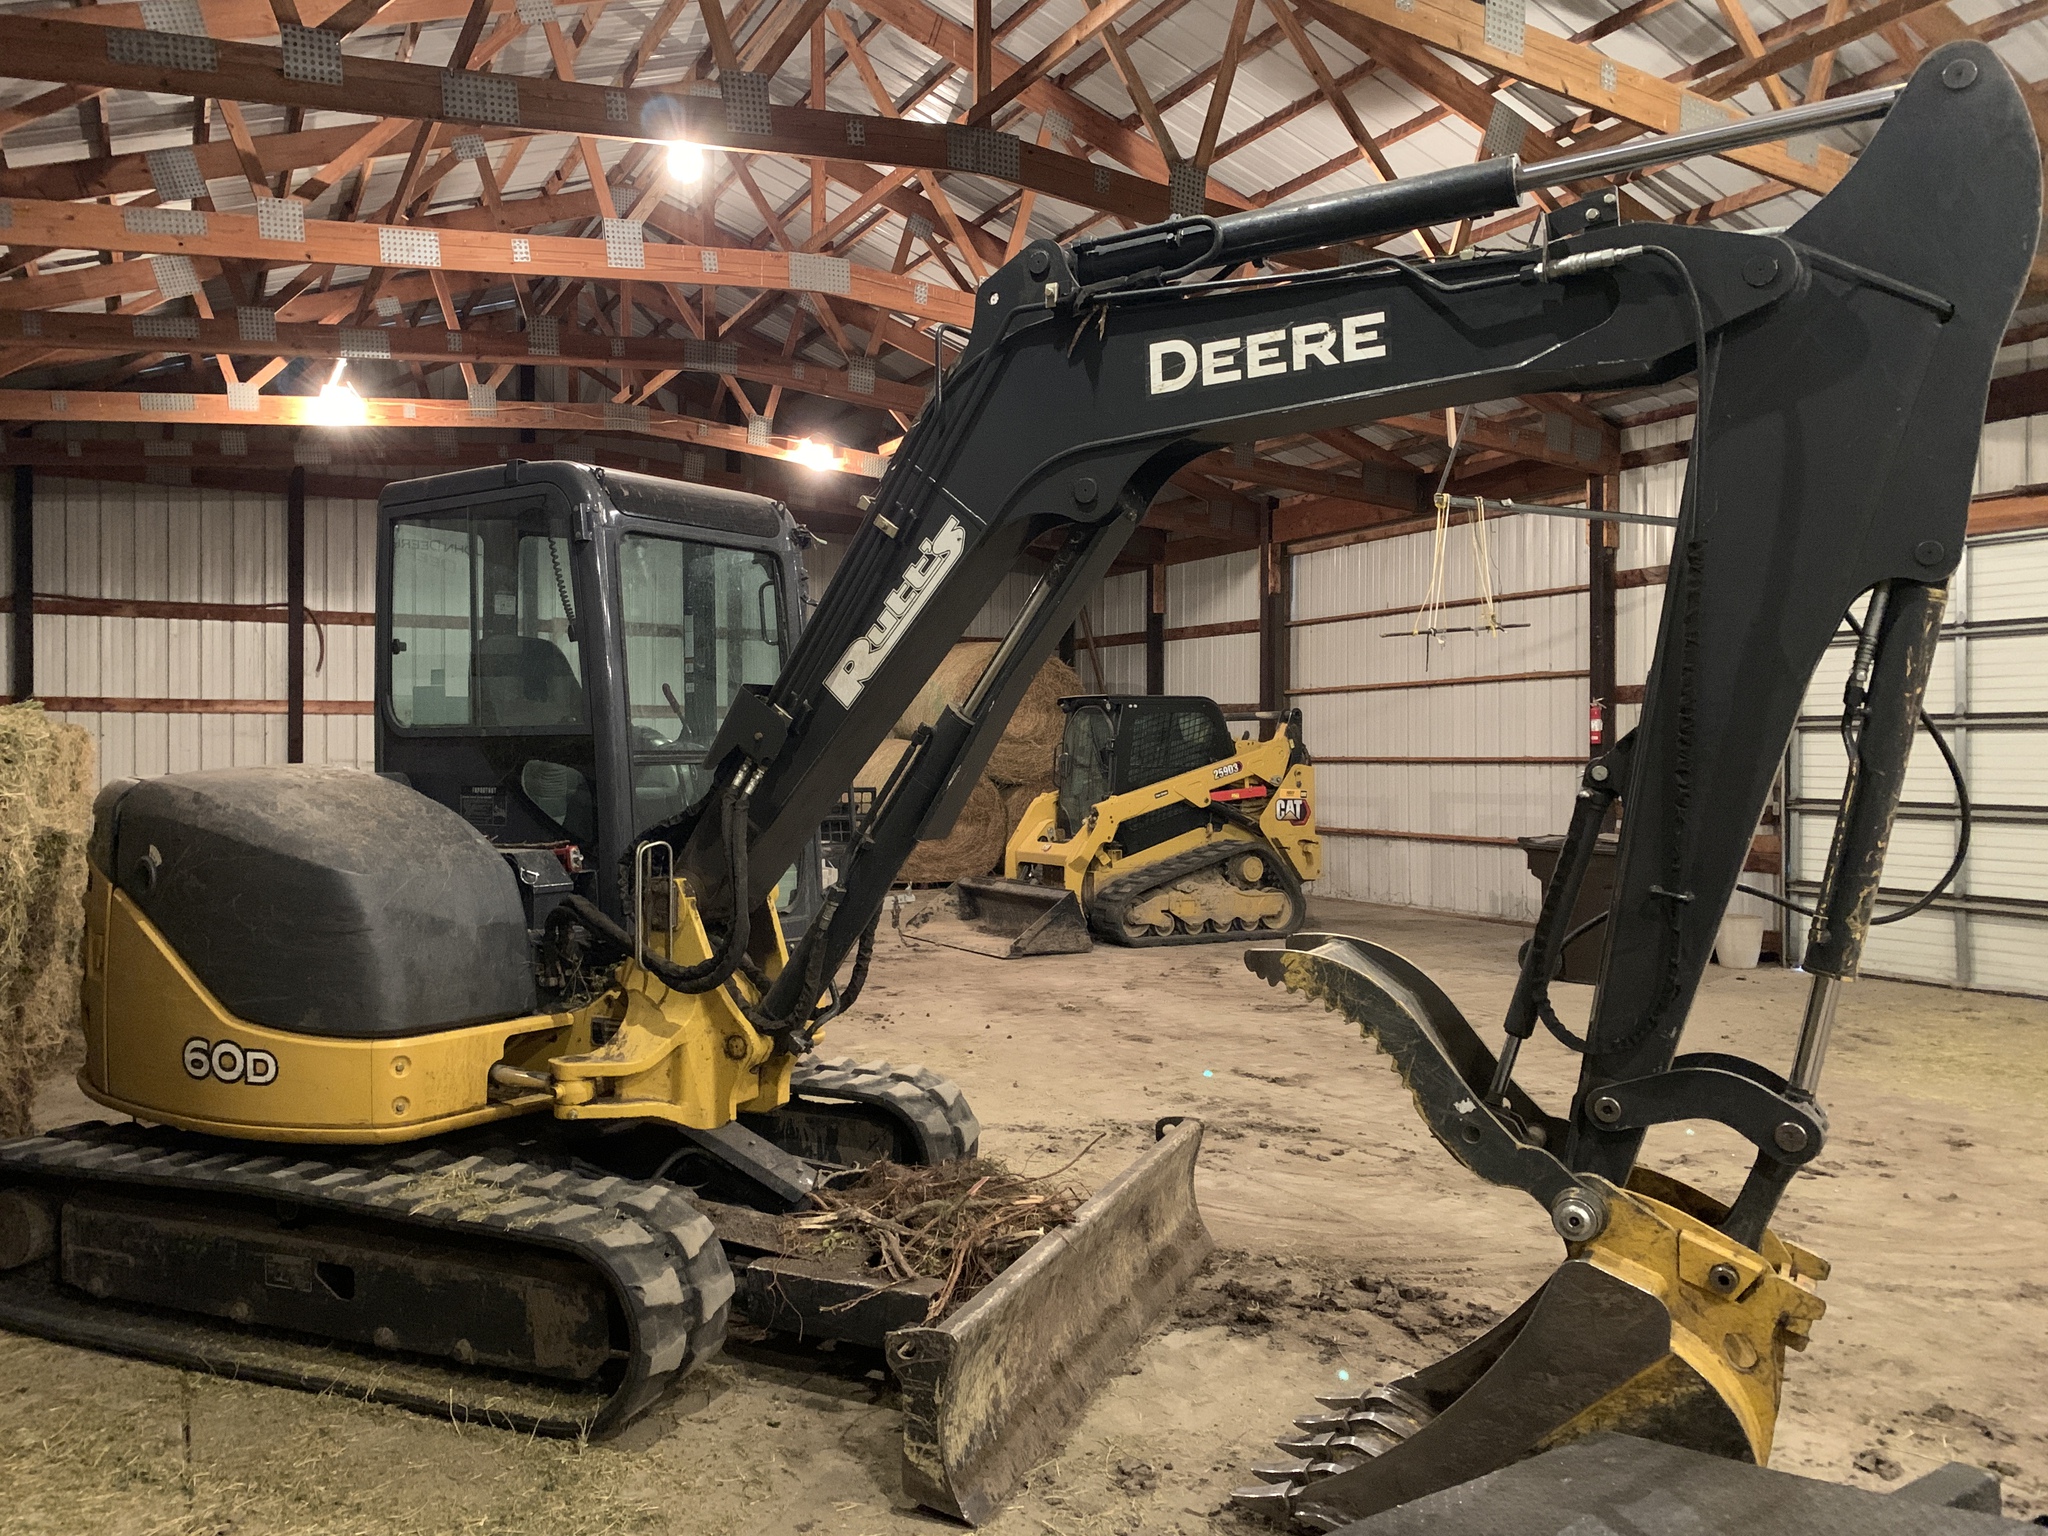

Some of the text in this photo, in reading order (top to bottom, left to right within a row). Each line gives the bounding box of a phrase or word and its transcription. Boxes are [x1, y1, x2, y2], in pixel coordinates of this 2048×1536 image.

[1149, 311, 1386, 394] DEERE
[1213, 763, 1239, 779] 259D3
[1276, 798, 1303, 821] CAT
[183, 1036, 279, 1086] 60D
